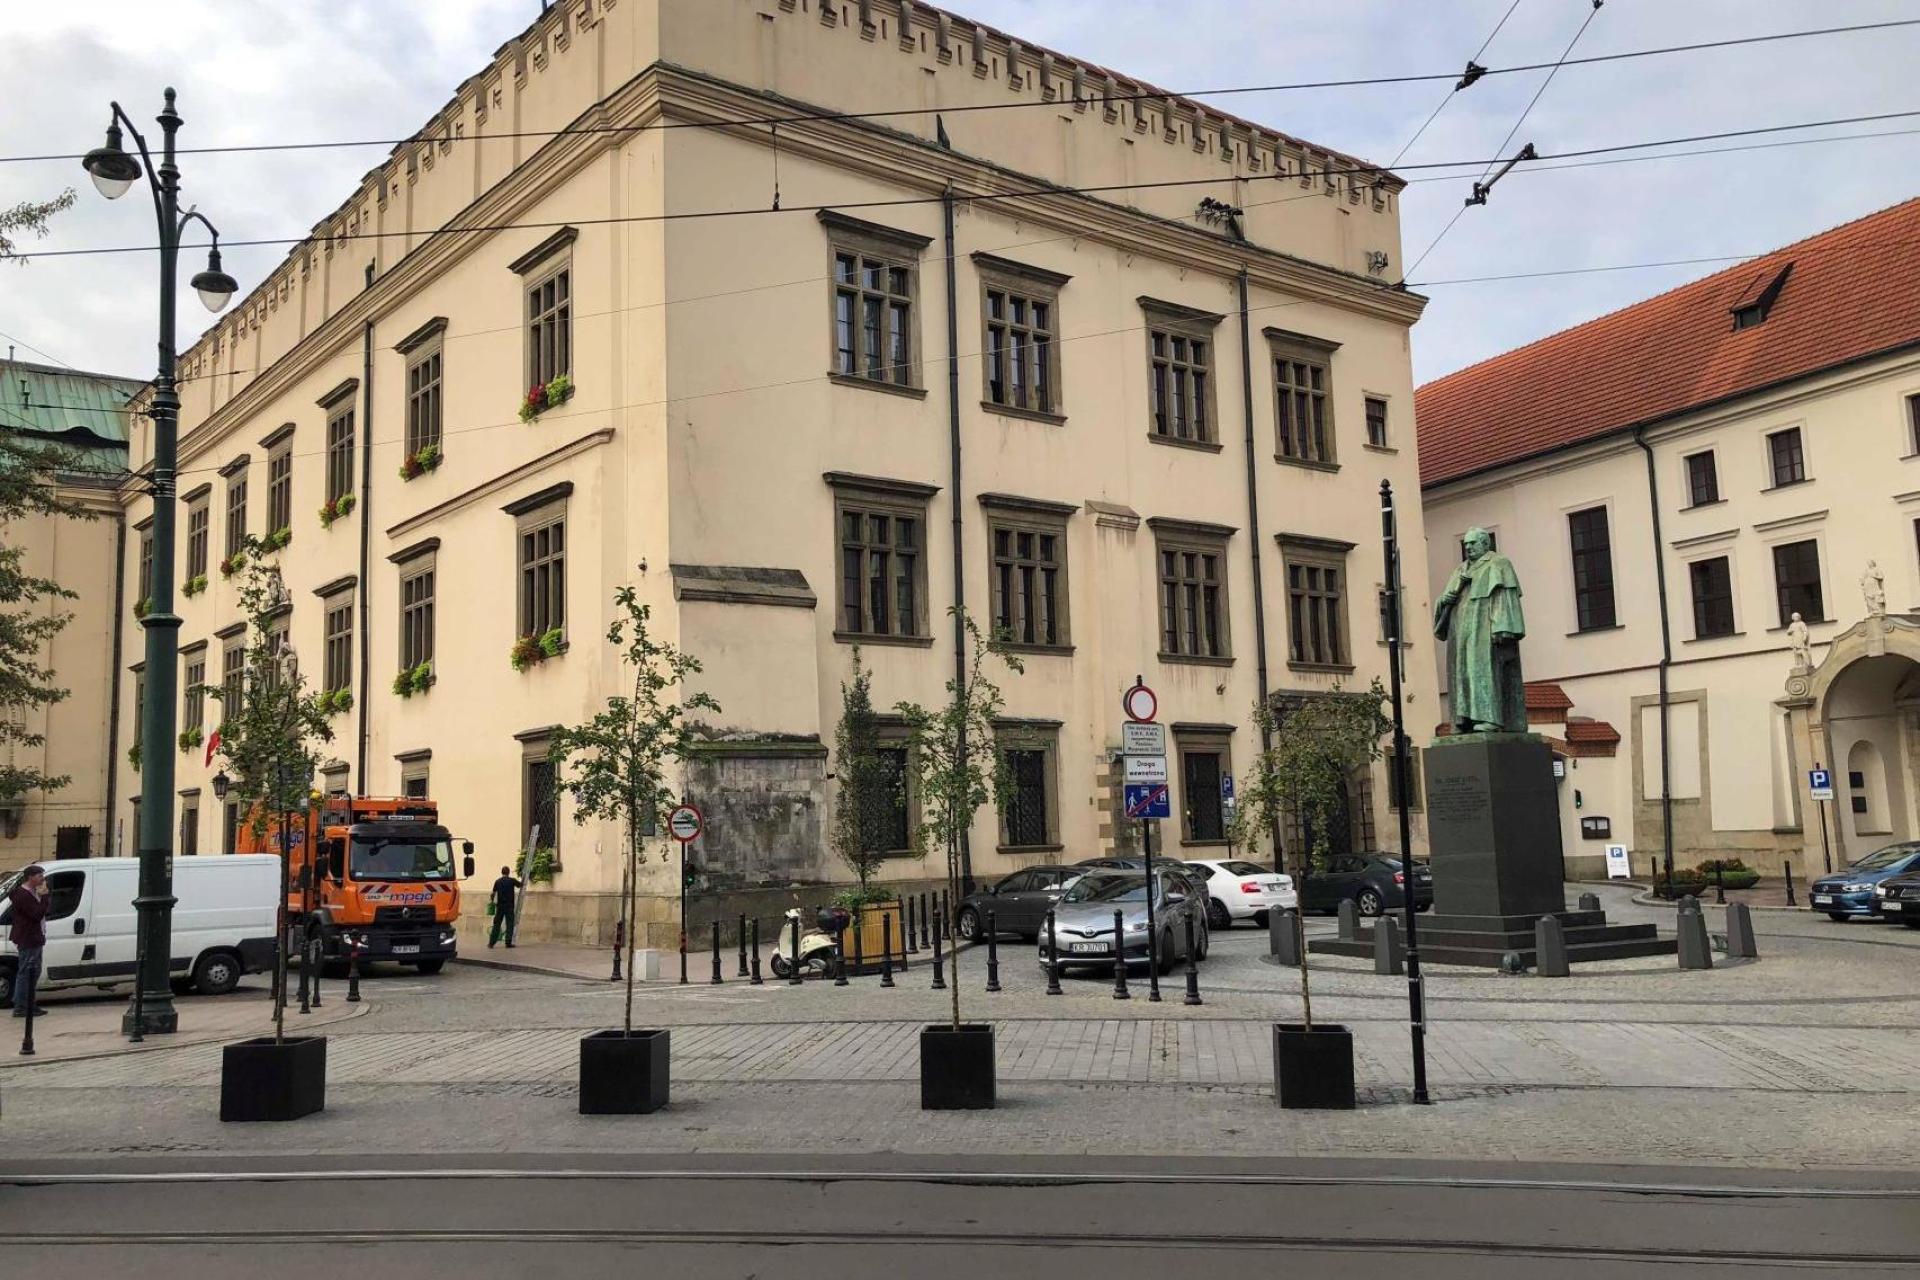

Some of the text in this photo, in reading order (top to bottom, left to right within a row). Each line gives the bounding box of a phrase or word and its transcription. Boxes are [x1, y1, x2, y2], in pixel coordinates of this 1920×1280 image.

[1137, 760, 1156, 768] Droga
[1813, 772, 1825, 786] P
[391, 893, 433, 905] mpgo
